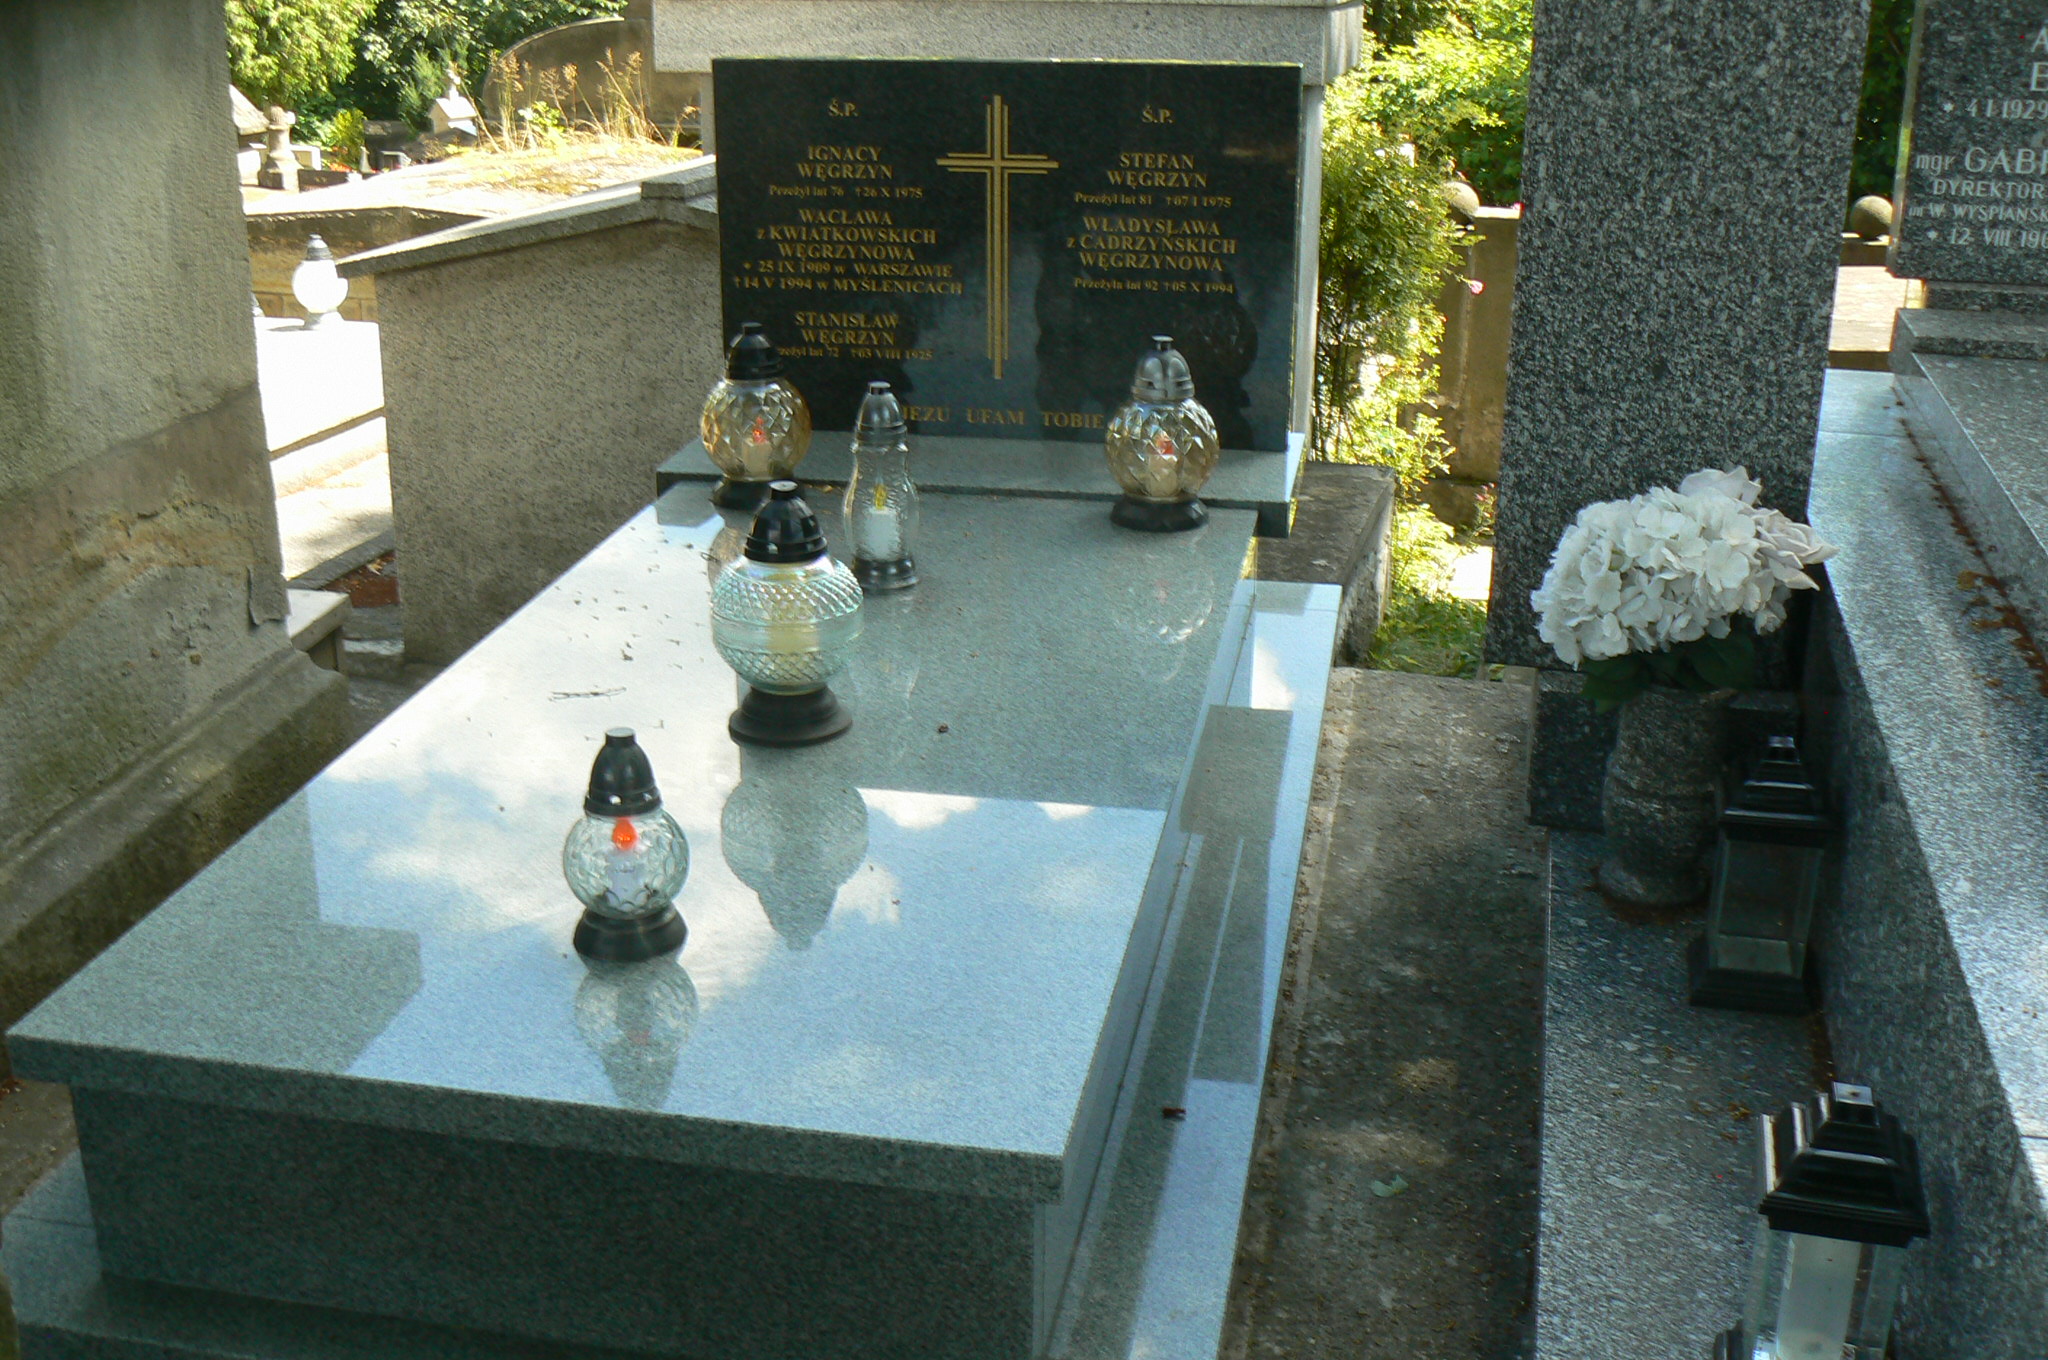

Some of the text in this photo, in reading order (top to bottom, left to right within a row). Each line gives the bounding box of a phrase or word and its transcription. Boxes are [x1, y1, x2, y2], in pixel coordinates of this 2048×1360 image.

[2002, 99, 2048, 120] 1929
[807, 145, 882, 162] IGNACY
[1120, 152, 1195, 170] STEFAN
[796, 162, 894, 182] WĘGRZYN
[1915, 154, 1956, 176] mgr
[1106, 169, 1208, 190] WĘGRZYN
[1933, 178, 2045, 199] DYREKTOR
[813, 185, 828, 197] lat
[831, 186, 845, 197] 76
[881, 188, 891, 198] X
[895, 187, 924, 199] 1975
[1121, 194, 1136, 205] lat
[1202, 196, 1233, 208] 1975
[757, 225, 938, 245] z KWIATKOWSKICH
[1066, 237, 1076, 248] z
[1950, 228, 1971, 245] 12
[1983, 228, 2011, 246] VIII
[778, 243, 916, 262] WĘGRZYNOWA
[1078, 251, 1224, 272] WĘGRZYNOWA
[759, 260, 774, 273] 25
[778, 260, 796, 273] IX
[834, 265, 845, 275] w
[853, 263, 953, 278] WARSZAWIE
[763, 277, 775, 289] V
[779, 277, 813, 290] 1994
[817, 281, 829, 291] w
[833, 277, 964, 295] MYŚLENICACH
[1126, 279, 1141, 290] lat
[1191, 282, 1200, 292] X
[1205, 282, 1234, 294] 1994
[801, 328, 896, 348] WĘGRZYN
[809, 346, 823, 358] lat
[876, 348, 900, 360] VIII
[966, 407, 1026, 426] UFAM
[1041, 411, 1104, 429] TOBIE
